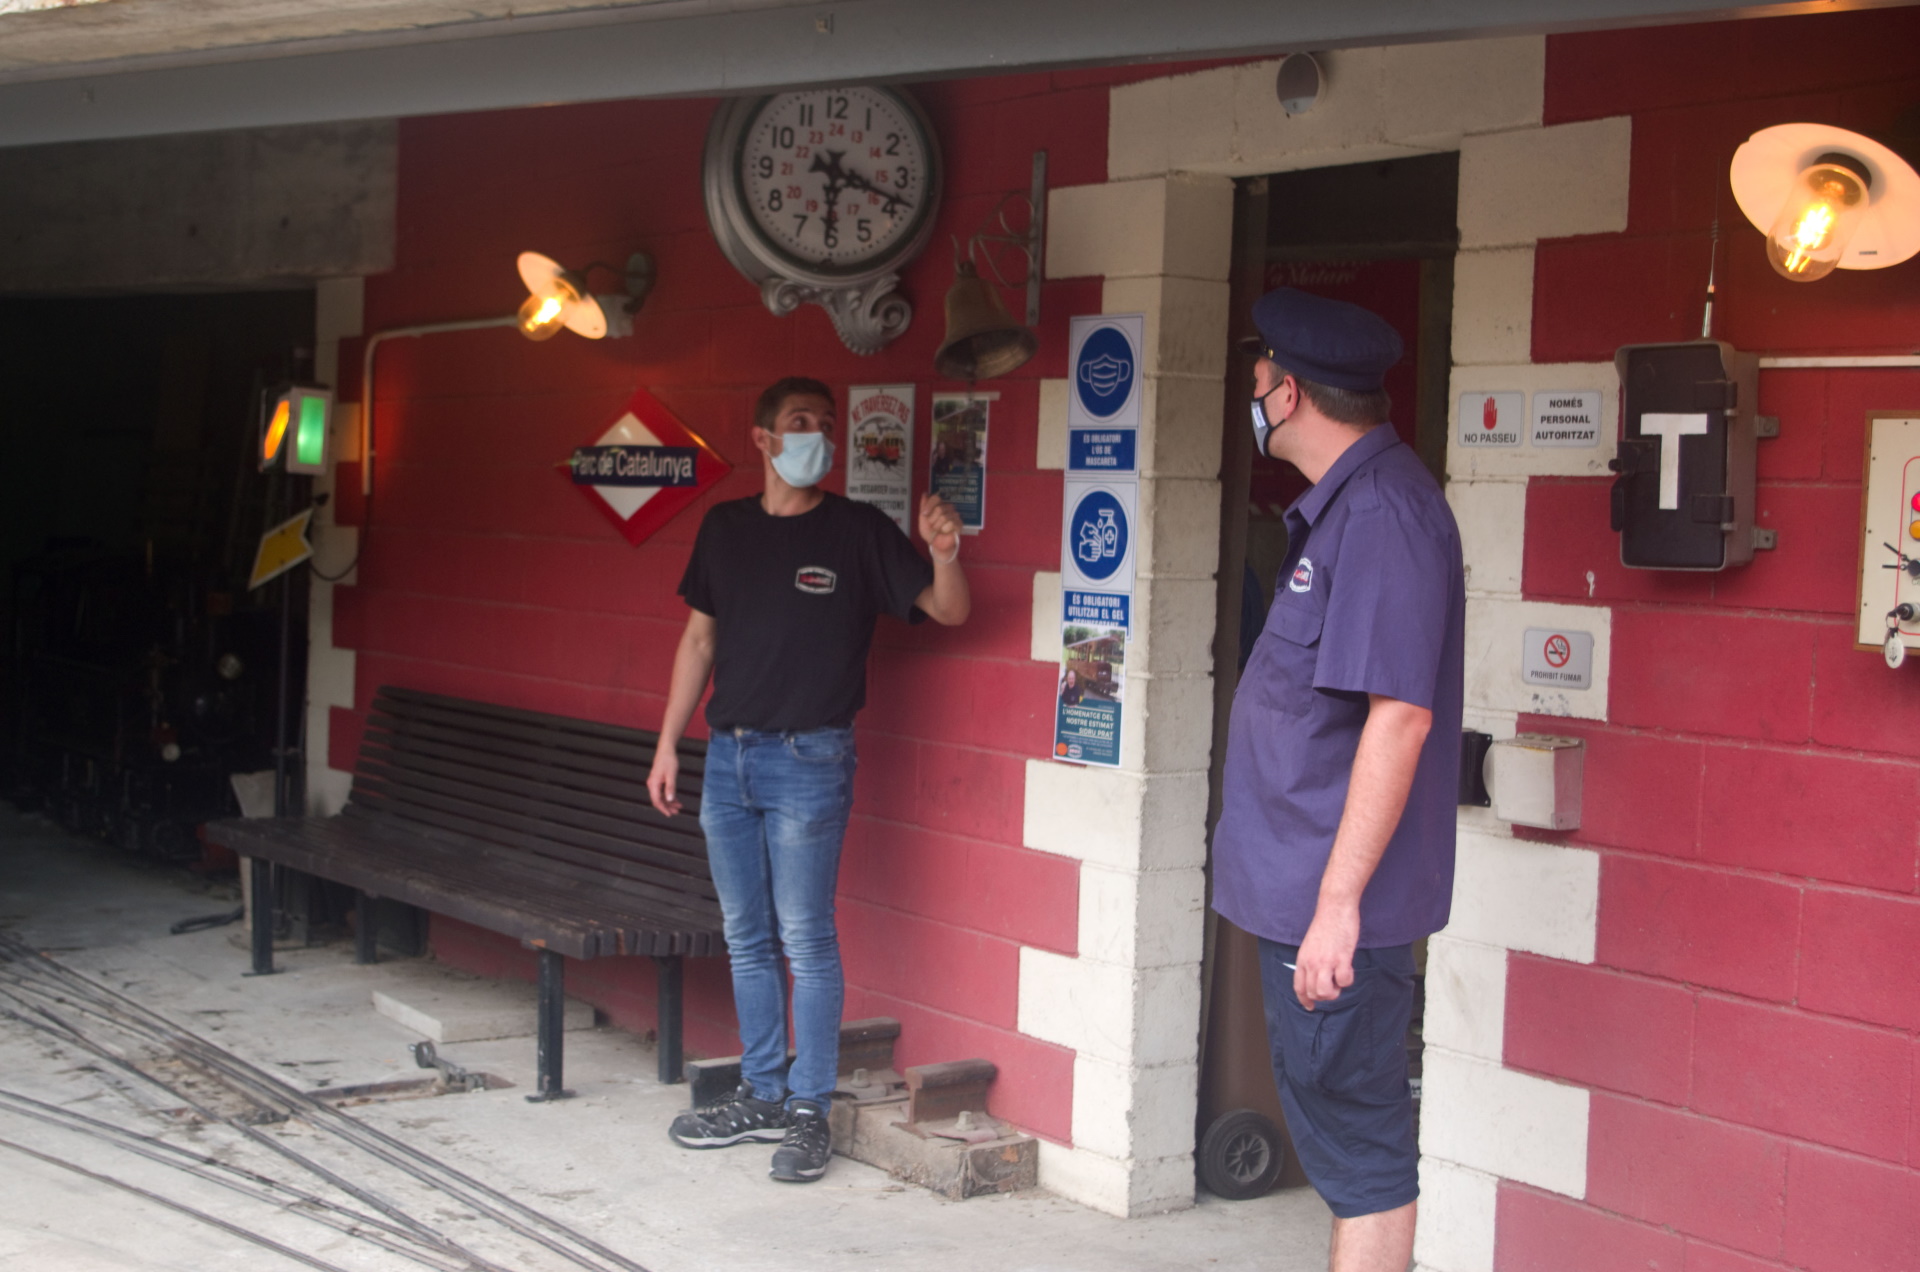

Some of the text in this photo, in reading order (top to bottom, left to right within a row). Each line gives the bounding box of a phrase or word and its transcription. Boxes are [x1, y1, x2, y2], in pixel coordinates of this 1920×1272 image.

[826, 96, 848, 120] 12
[800, 104, 814, 127] 11
[865, 108, 871, 131] 1
[829, 124, 845, 137] 24
[772, 126, 795, 149] 10
[809, 132, 824, 145] 23
[852, 131, 863, 144] 13
[886, 133, 900, 156] 2
[796, 147, 810, 159] 22
[870, 148, 881, 159] 14
[759, 156, 773, 179] 9
[781, 163, 793, 176] 21
[876, 171, 888, 183] 15
[895, 166, 909, 190] 3
[787, 186, 802, 200] 20
[768, 189, 783, 213] 8
[806, 200, 818, 213] 19
[847, 205, 860, 216] 17
[882, 198, 898, 219] 4
[793, 214, 808, 238] 7
[857, 219, 871, 243] 5
[824, 223, 838, 248] 6
[860, 395, 898, 417] TRAVERSEZ
[1549, 397, 1582, 408] NOMÉS
[1540, 415, 1590, 424] PERSONAL
[1091, 434, 1121, 443] OBLIGATORI
[1464, 433, 1516, 444] NO PASSEU
[1535, 430, 1595, 440] AUTORITZAT
[574, 450, 692, 484] Parc de Catalunya
[1085, 457, 1117, 466] MASCARETA
[1640, 413, 1708, 510] T
[1072, 594, 1120, 607] ÉS OBLIGATORI
[1068, 606, 1124, 620] UTILITZAR EL GEL
[1531, 671, 1582, 682] PROHIBIT FUMAR
[1062, 708, 1114, 721] L'HOMENATGE DEL
[1066, 717, 1114, 730] NOSTRE ESTIMAT
[1098, 730, 1114, 738] PRAT
